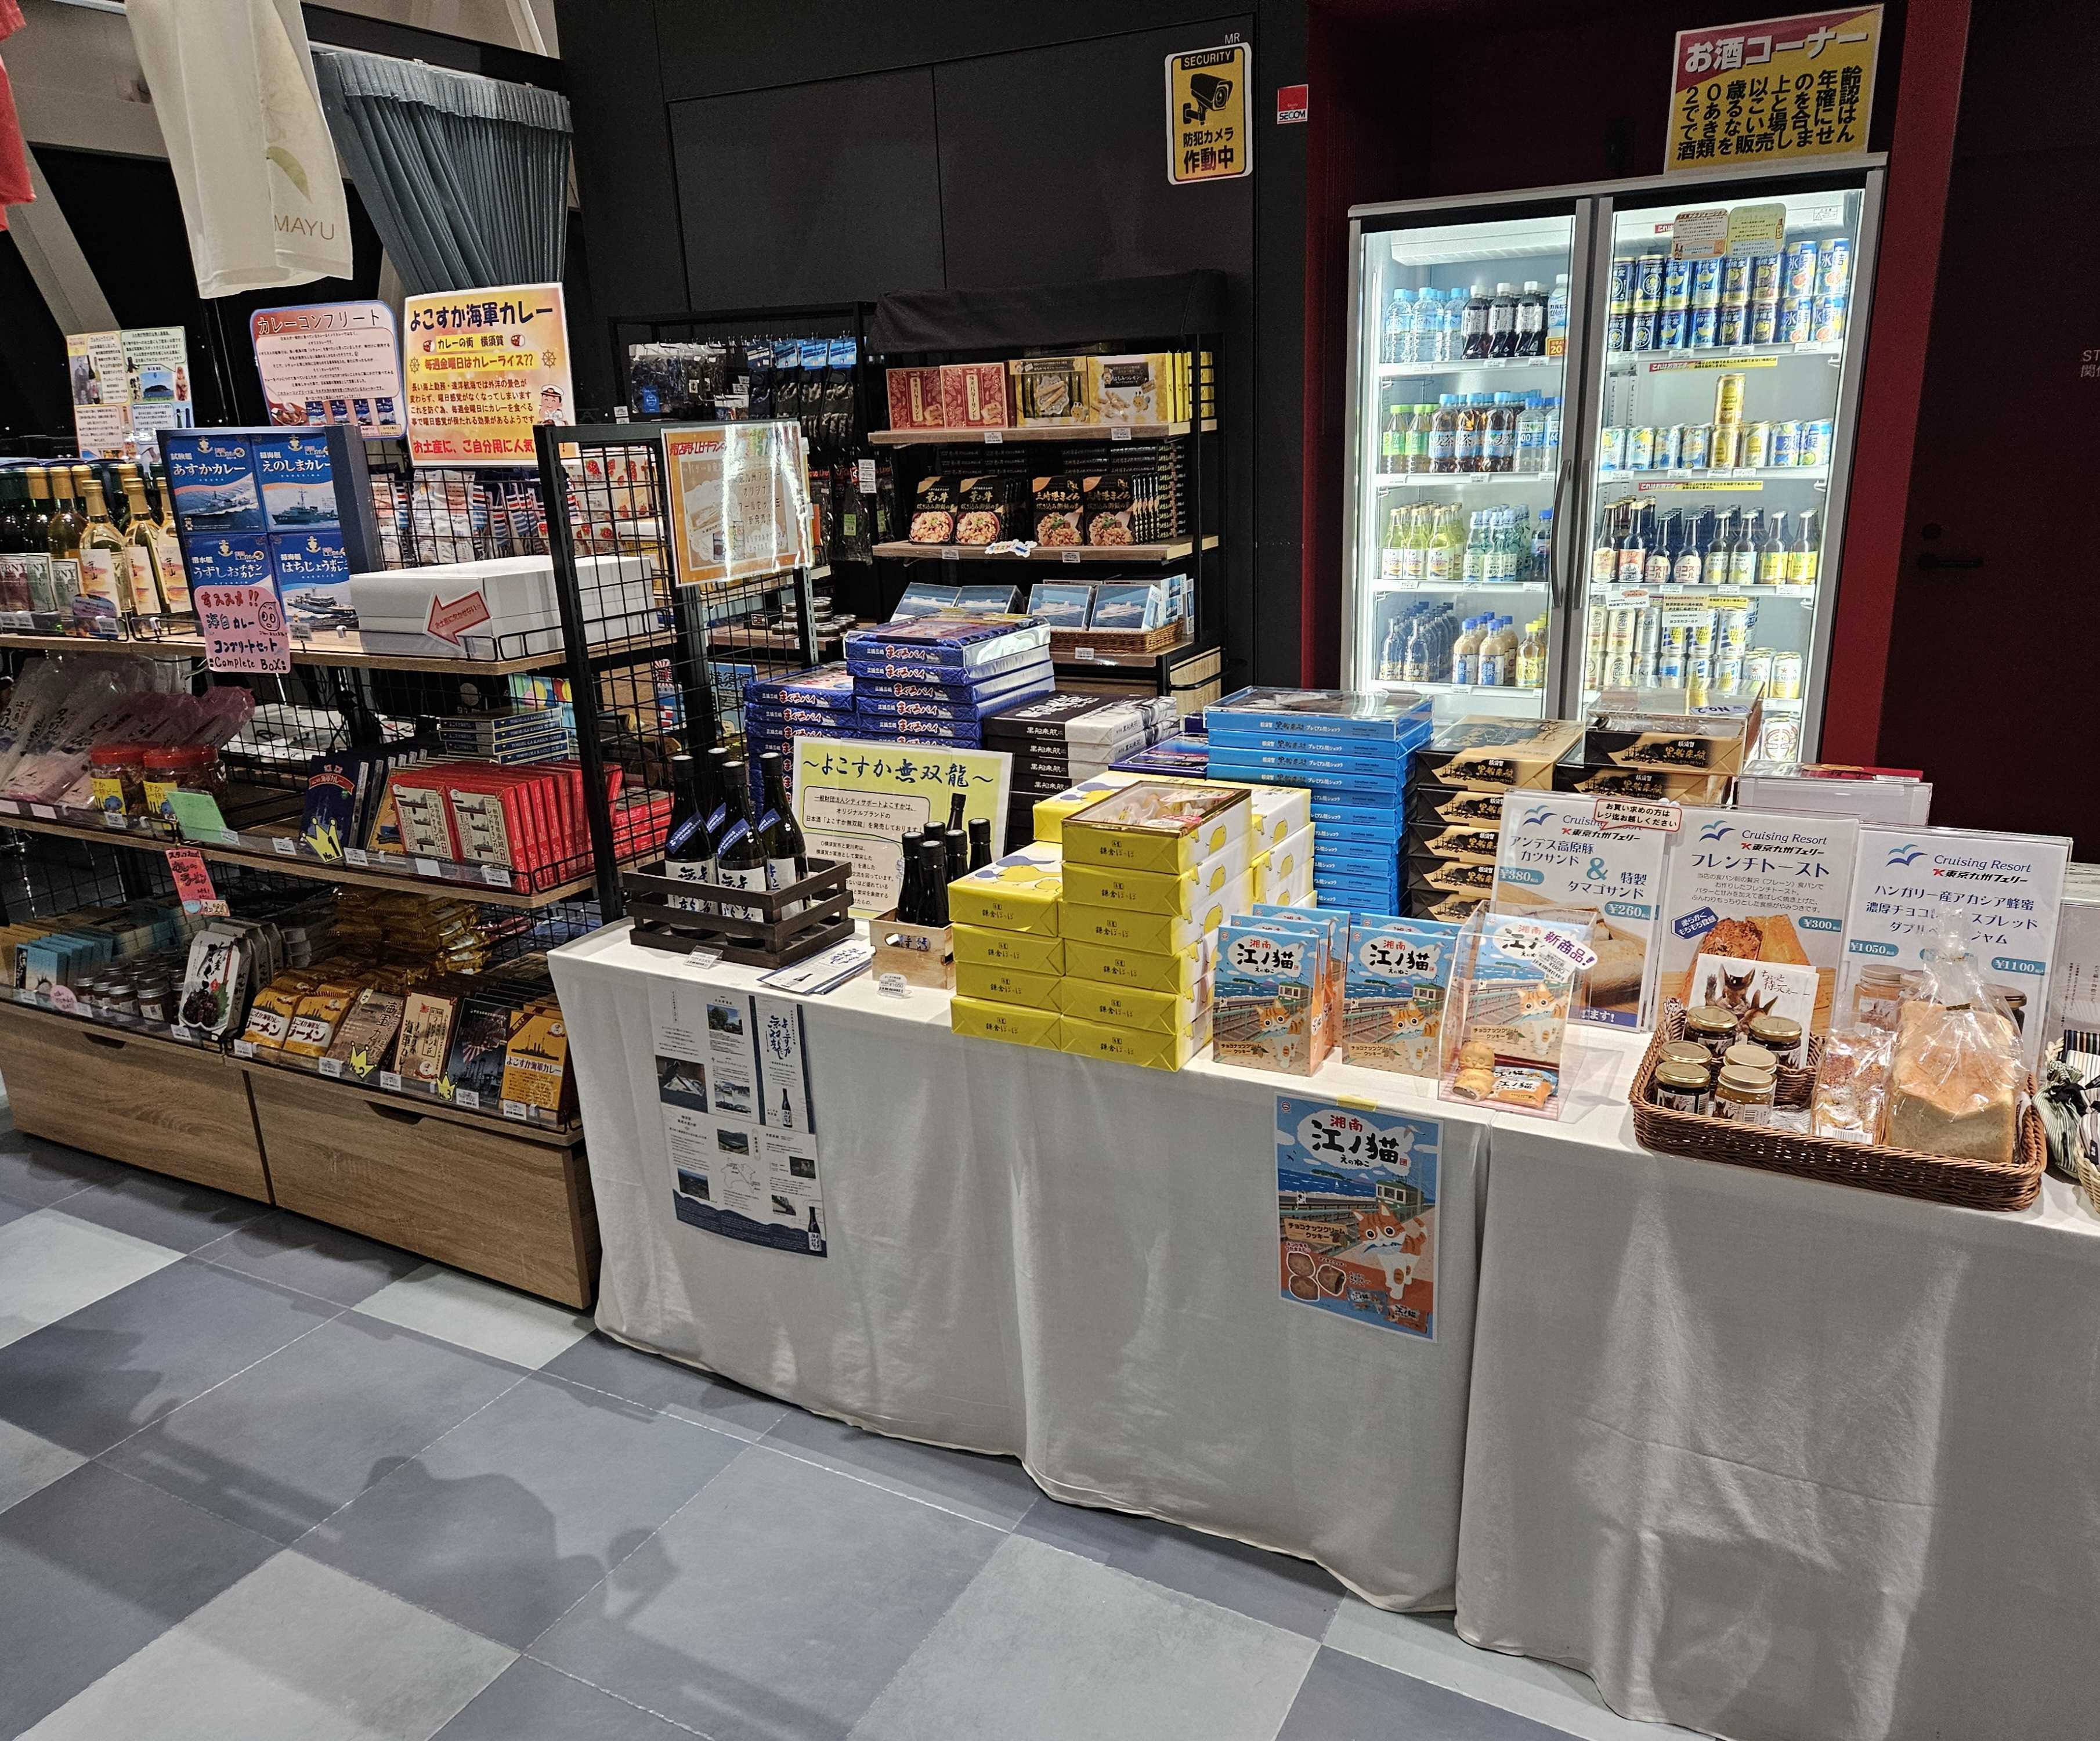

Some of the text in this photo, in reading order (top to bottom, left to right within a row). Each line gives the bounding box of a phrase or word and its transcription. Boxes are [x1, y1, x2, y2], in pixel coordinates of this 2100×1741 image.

[1225, 32, 1240, 45] MR
[1685, 26, 1868, 73] お酒コーナー
[1184, 51, 1231, 67] SECURITY
[1683, 85, 1860, 122] であることを確認
[1279, 110, 1306, 120] SECOM
[1680, 106, 1856, 140] できない場合には
[1183, 127, 1234, 147] 防犯カメラ
[1676, 125, 1855, 161] 酒類を販売しません
[1183, 146, 1234, 174] 作動中
[274, 215, 334, 240] MAYU
[410, 301, 553, 332] よこすか海軍カレー
[438, 334, 504, 349] カレーの街 横須賀
[413, 439, 534, 454] お土産に、ご自分用に人気
[173, 464, 245, 476] あすかカレー
[263, 459, 331, 472] えのしまカレー
[193, 566, 239, 579] うずしお
[282, 561, 330, 573] はちじょう
[884, 645, 926, 660] まぐろパイ
[215, 657, 255, 668] Complete
[885, 664, 926, 679] まぐろパイ
[779, 689, 817, 704] まぐろパイ
[893, 682, 934, 698] まぐろパイ
[783, 708, 822, 723] まぐろパイ
[896, 701, 938, 716] まぐろパイ
[898, 718, 939, 734] まぐろパイ
[814, 795, 916, 812] 一般財団法人シティサポートよこすかは、
[1606, 803, 1670, 817] お買い求めの方は
[836, 808, 891, 819] オリジナルブランドの
[1597, 811, 1677, 827] レジ迄お越しください
[1573, 830, 1640, 841] 東京九州フェリー
[1742, 830, 1828, 845] Cruising Resort
[1510, 836, 1595, 854] アンデス高原豚
[1752, 844, 1825, 856] 東京九州フェリー
[1521, 851, 1609, 881] カツサンド &
[1691, 854, 1830, 877] フレンチトースト
[1934, 855, 2033, 872] Cruising Resort
[1621, 872, 1647, 886] 特製
[1946, 870, 2029, 884] 東京九州フェリー
[1568, 881, 1643, 899] タマゴサンド
[1715, 882, 1799, 895] お作りしたフレンチトースト。
[1875, 885, 2034, 911] ハンガリー産アカシア蜂蜜
[1607, 903, 1642, 916] ¥260
[1803, 919, 1832, 930] ¥300
[1972, 913, 2038, 930] スプレッド
[1250, 939, 1271, 949] 湘南
[1383, 940, 1405, 951] 湘南
[1237, 943, 1295, 970] 江ノ猫
[1369, 942, 1430, 971] 江ノ猫
[1255, 967, 1275, 975] えのねこ
[1387, 967, 1408, 975] えのねこ
[507, 1056, 562, 1074] よこすか海軍カレー
[1331, 1114, 1363, 1132] 湘南
[1311, 1119, 1400, 1165] 江ノ猫
[1340, 1156, 1370, 1168] えのねこ
[1288, 1222, 1346, 1236] チョコナッツクリーム
[1306, 1231, 1331, 1240] クッキー
